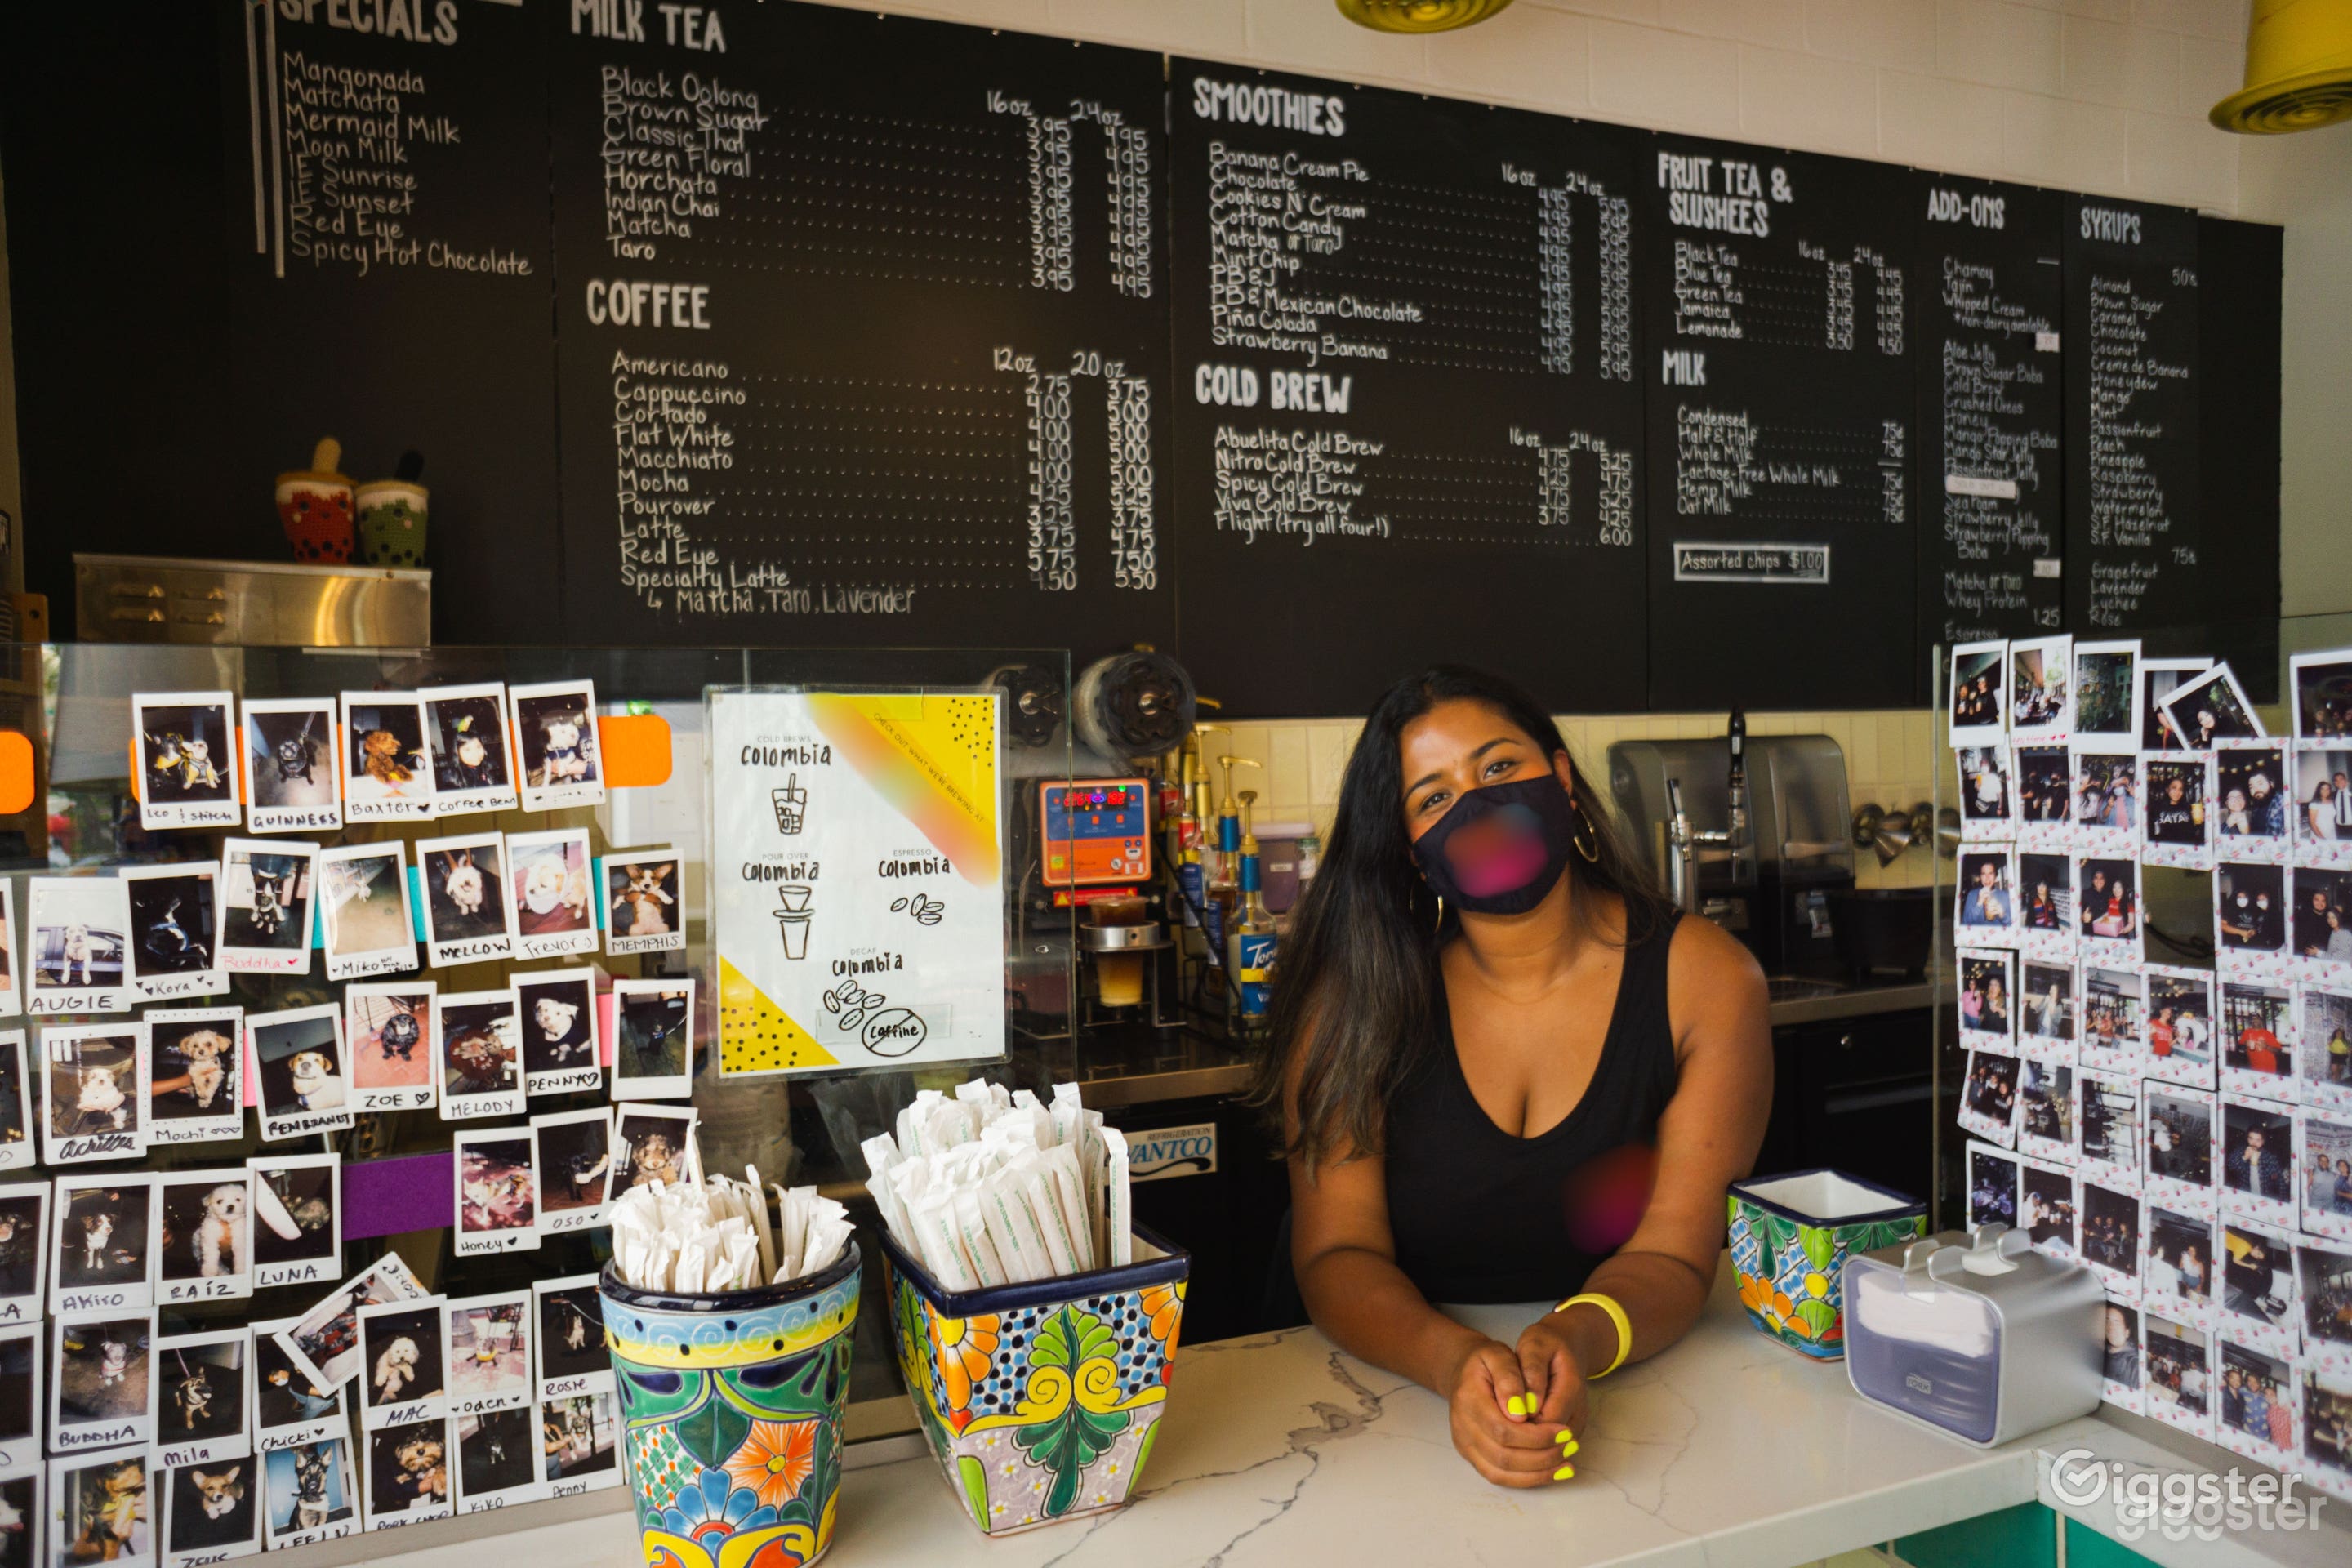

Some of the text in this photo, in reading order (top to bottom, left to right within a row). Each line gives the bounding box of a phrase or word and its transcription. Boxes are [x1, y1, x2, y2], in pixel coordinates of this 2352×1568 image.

[571, 0, 725, 53] MILK TEA
[284, 51, 424, 94] Mangonada
[285, 78, 399, 114] Matchata
[602, 65, 759, 115] Black Oolong
[602, 92, 769, 131] Brown Sugar
[1193, 77, 1344, 137] SMOOTHIES
[287, 103, 460, 144] Mermaid Milk
[604, 116, 744, 153] Classic Thai
[287, 129, 407, 163] Moon Milk
[600, 140, 751, 178] Green Floral
[322, 158, 417, 191] Sunrise
[1209, 142, 1370, 182] Banana Cream Pie
[605, 164, 717, 195] Horchata
[1209, 163, 1297, 191] Chocolate
[1658, 151, 1794, 203] FRUIT TEA &
[322, 181, 414, 215] Sunset
[606, 188, 719, 217] Indian Chai
[1927, 187, 2005, 230] ADD-ONS
[291, 203, 403, 250] Red Eye
[608, 211, 691, 238] Matcha
[1210, 204, 1342, 251] Cotton Candy
[1669, 191, 1770, 238] SLUSHEES
[2080, 207, 2141, 245] SYRUPS
[606, 234, 655, 260] Taro
[1211, 225, 1279, 252] Matcha
[291, 230, 533, 278] Spicy Hot Chocolate
[1212, 246, 1301, 276] Mint Chip
[1675, 242, 1738, 266] Black Tea
[586, 279, 710, 329] COFFEE
[1675, 298, 1731, 320] Jamaica
[1211, 305, 1317, 333] Piña Colada
[1676, 315, 1743, 339] Lemonade
[1212, 327, 1388, 368] Strawberry Banana
[612, 349, 728, 380] Americano
[1662, 350, 1706, 385] MILK
[615, 376, 746, 415] Cappuccino
[1196, 364, 1351, 414] COLD BREW
[615, 401, 706, 424] Cortado
[1677, 404, 1748, 428] Condensed
[613, 423, 734, 448] Flat White
[1214, 426, 1383, 457] Abuelita Cold Brew
[617, 447, 733, 471] Macchiato
[1215, 448, 1357, 474] Nitro Cold Brew
[1678, 443, 1720, 461] Whole
[618, 470, 689, 492] Mocha
[1215, 470, 1362, 497] Spicy Cold Brew
[617, 492, 715, 515] Pourover
[1214, 489, 1352, 514] Viva Cold Brew
[619, 514, 687, 539] Latte
[1214, 510, 1388, 546] Flight (try all four!)
[621, 538, 719, 571] Red Eye
[1682, 552, 1742, 572] Assorted
[1748, 551, 1780, 575] chips
[621, 563, 790, 596] Specialty Latte
[824, 587, 916, 613] Lavender
[757, 736, 811, 744] COLD BREWS
[874, 713, 893, 735] CHECK
[894, 734, 908, 747] OUT
[908, 747, 929, 768] WHAT
[946, 785, 974, 814] BREWING
[352, 803, 415, 817] Baxter
[763, 852, 808, 862] POUR OVER
[893, 849, 932, 858] ESPRESSO
[439, 941, 510, 960] MELLOW
[612, 935, 679, 954] MEMPHIS
[851, 947, 876, 955] DECAF
[155, 981, 191, 996] Kora
[29, 995, 113, 1013] AUGIE
[528, 1073, 585, 1093] PENNY
[364, 1093, 403, 1107] ZOE
[451, 1099, 514, 1118] MELODY
[156, 1127, 205, 1142] Mochi
[461, 1239, 503, 1258] Honey
[260, 1265, 318, 1287] LUNA
[385, 1405, 430, 1428] MAC
[59, 1425, 136, 1448] BUDDHA
[165, 1447, 210, 1467] Mila
[552, 1481, 587, 1501] Penny
